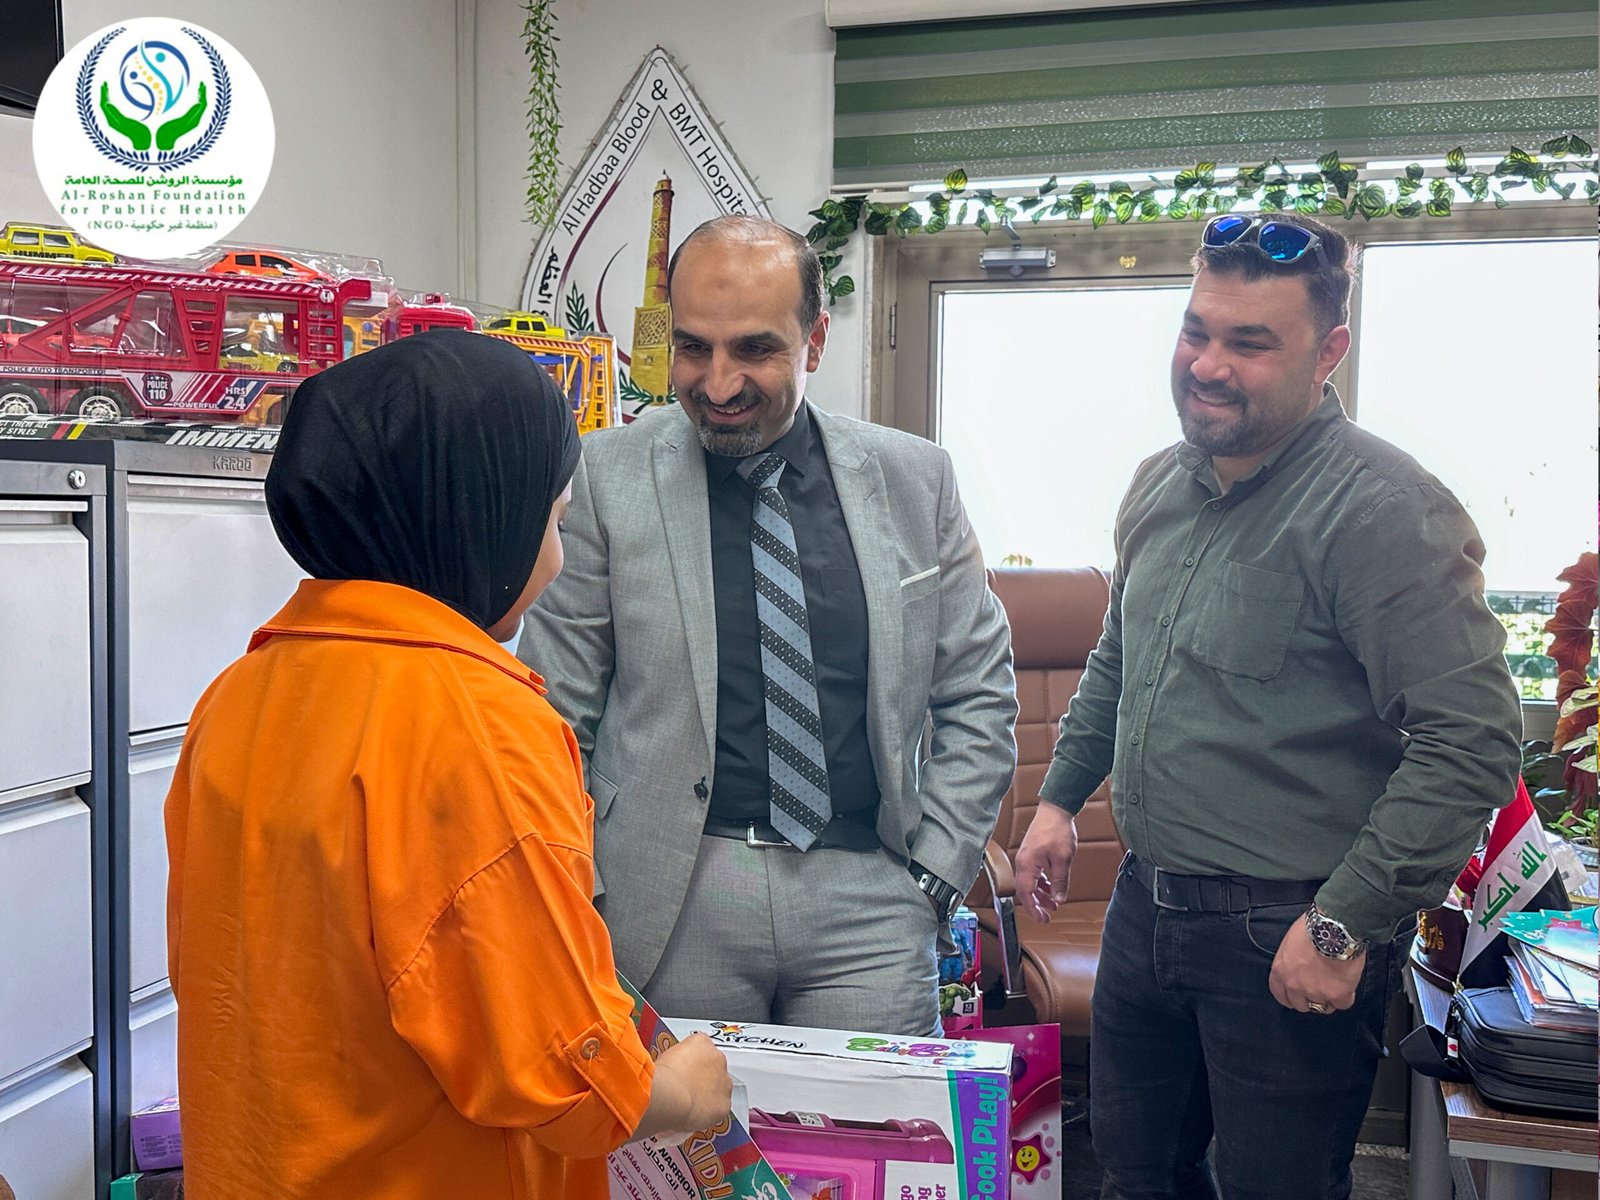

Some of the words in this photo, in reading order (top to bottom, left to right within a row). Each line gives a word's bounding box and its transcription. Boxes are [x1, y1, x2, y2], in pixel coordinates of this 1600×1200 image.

[561, 213, 580, 237] Al
[576, 154, 621, 219] Hadbaa
[611, 102, 652, 155] Blood
[650, 78, 669, 102] &
[668, 102, 707, 146] BMT
[30, 366, 53, 374] AUTO
[147, 380, 169, 390] POLICE
[149, 389, 167, 400] 110
[225, 386, 246, 395] HRS
[173, 401, 219, 410] POWERFUL
[224, 396, 246, 410] 24
[1514, 840, 1548, 880] الله
